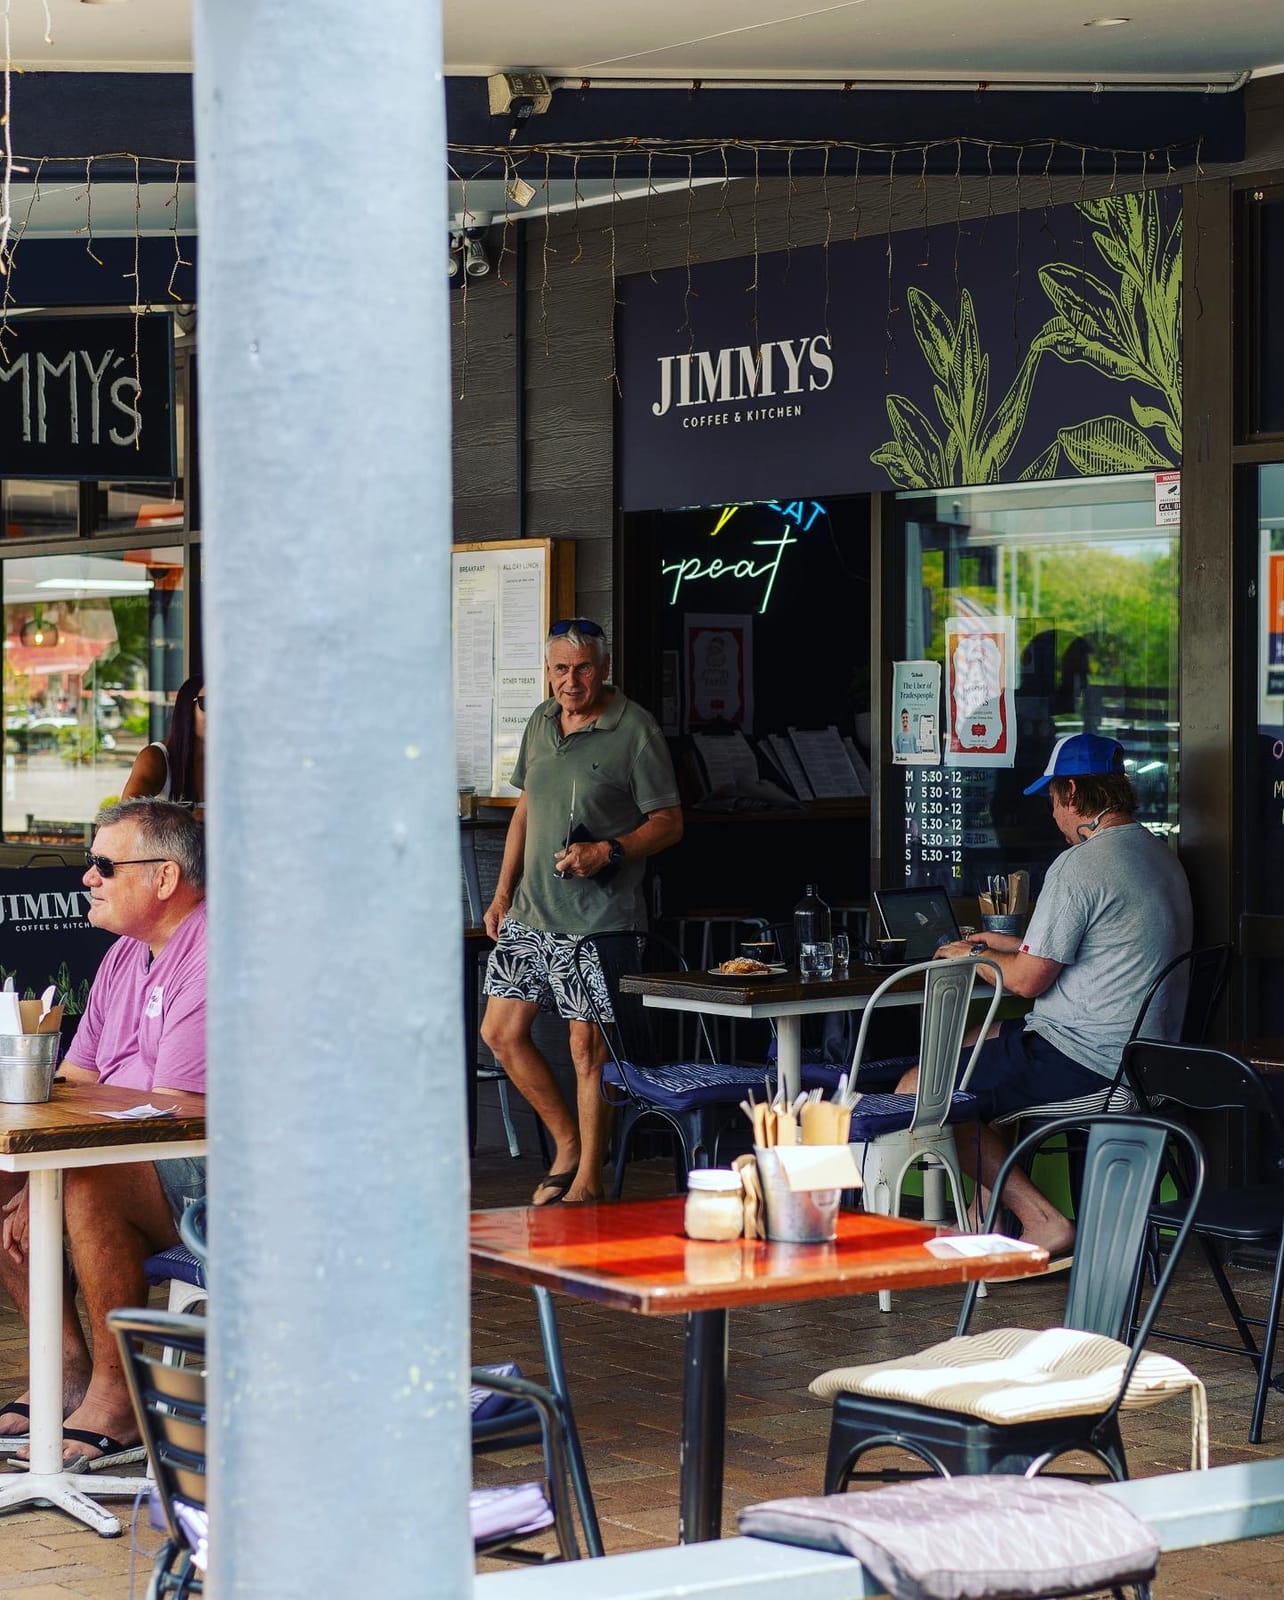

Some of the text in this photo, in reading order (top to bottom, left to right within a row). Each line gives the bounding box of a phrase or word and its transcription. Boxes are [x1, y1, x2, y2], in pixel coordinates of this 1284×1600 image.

[652, 335, 834, 416] JIMMYS
[683, 405, 802, 428] COFFEE & KITCHEN
[768, 500, 827, 532] AT
[459, 565, 486, 573] BREAKFAST
[662, 524, 798, 614] peat
[502, 676, 536, 685] OTHER TREATS
[903, 681, 933, 690] The Uber of
[900, 691, 934, 701] Tradespeople
[905, 770, 914, 782] M
[921, 771, 943, 782] 5.30
[951, 771, 962, 783] 12
[905, 786, 912, 798] T
[951, 787, 962, 798] 12
[905, 802, 916, 813] W
[921, 802, 943, 814] 5.30
[951, 803, 962, 814] 12
[905, 817, 912, 829] T
[921, 818, 943, 829] 5.30
[951, 818, 962, 830] 12
[905, 833, 912, 845] F
[921, 834, 943, 845] 5.30
[951, 834, 962, 846] 12
[905, 849, 912, 860] S
[921, 849, 943, 861] 5.30
[951, 850, 962, 861] 12
[905, 864, 912, 876] S
[951, 866, 962, 877] 12
[15, 924, 50, 932] COFFEE
[62, 921, 95, 929] KITCH
